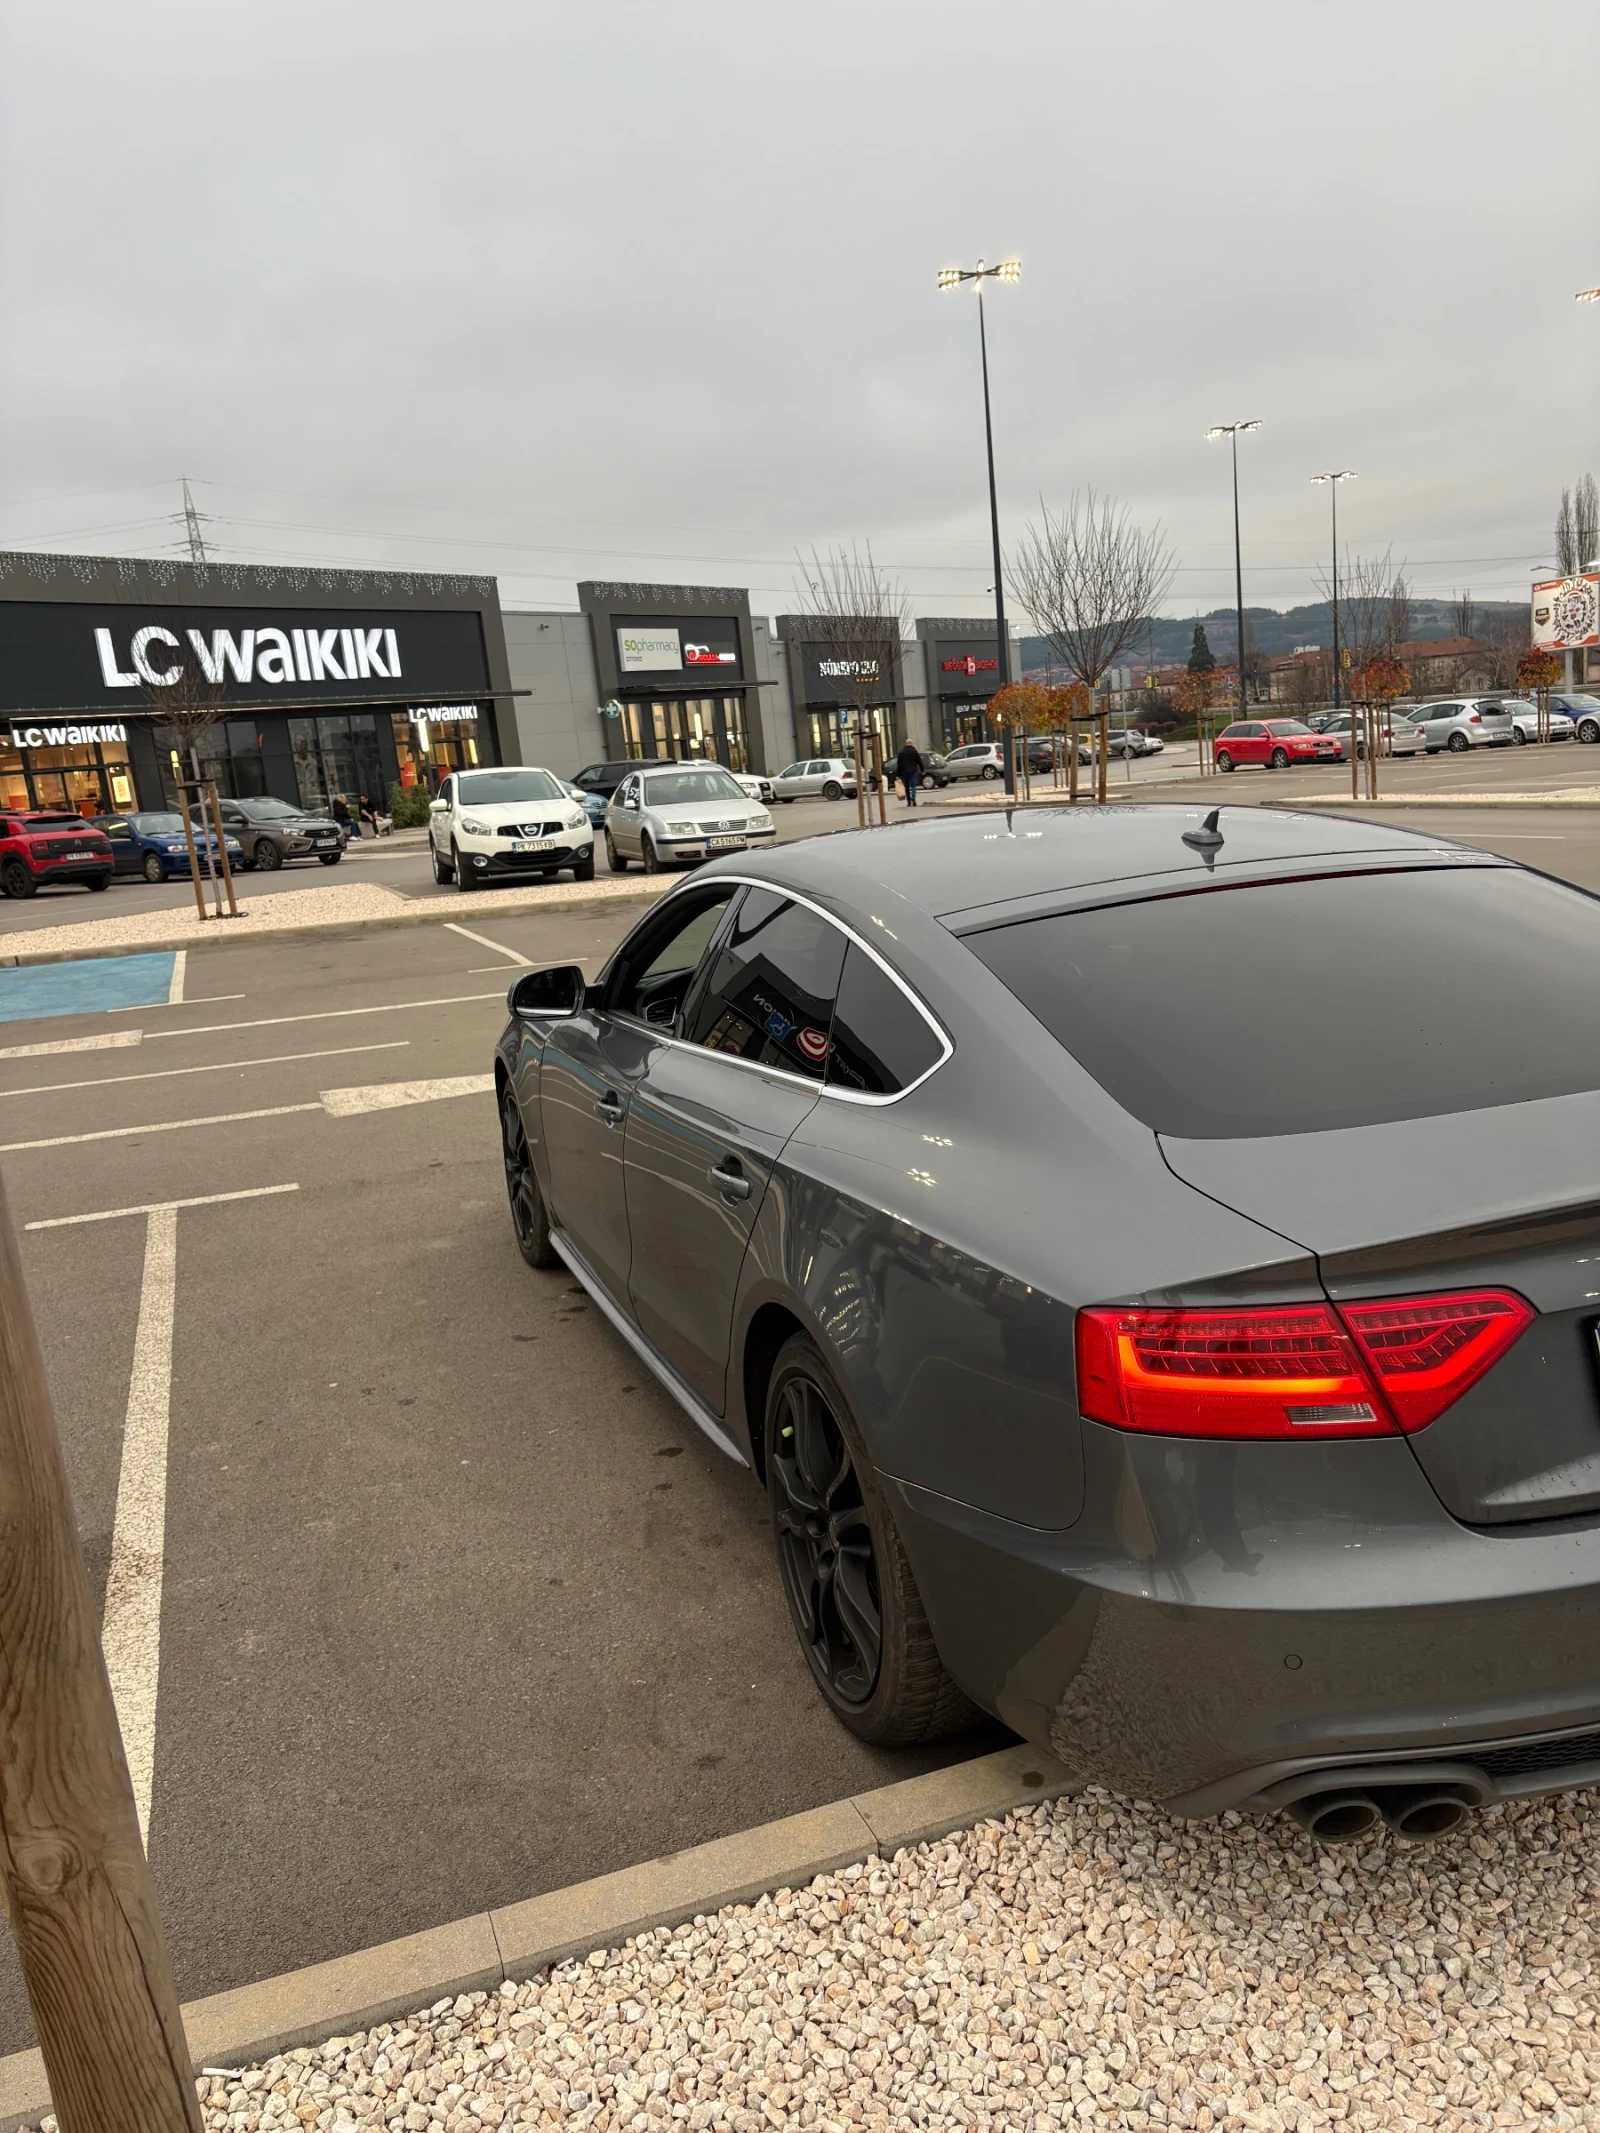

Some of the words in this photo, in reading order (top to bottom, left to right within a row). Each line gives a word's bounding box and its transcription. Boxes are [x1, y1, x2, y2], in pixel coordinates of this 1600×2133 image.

[94, 625, 184, 687] LC
[409, 707, 427, 722] LC
[12, 728, 43, 748] LC
